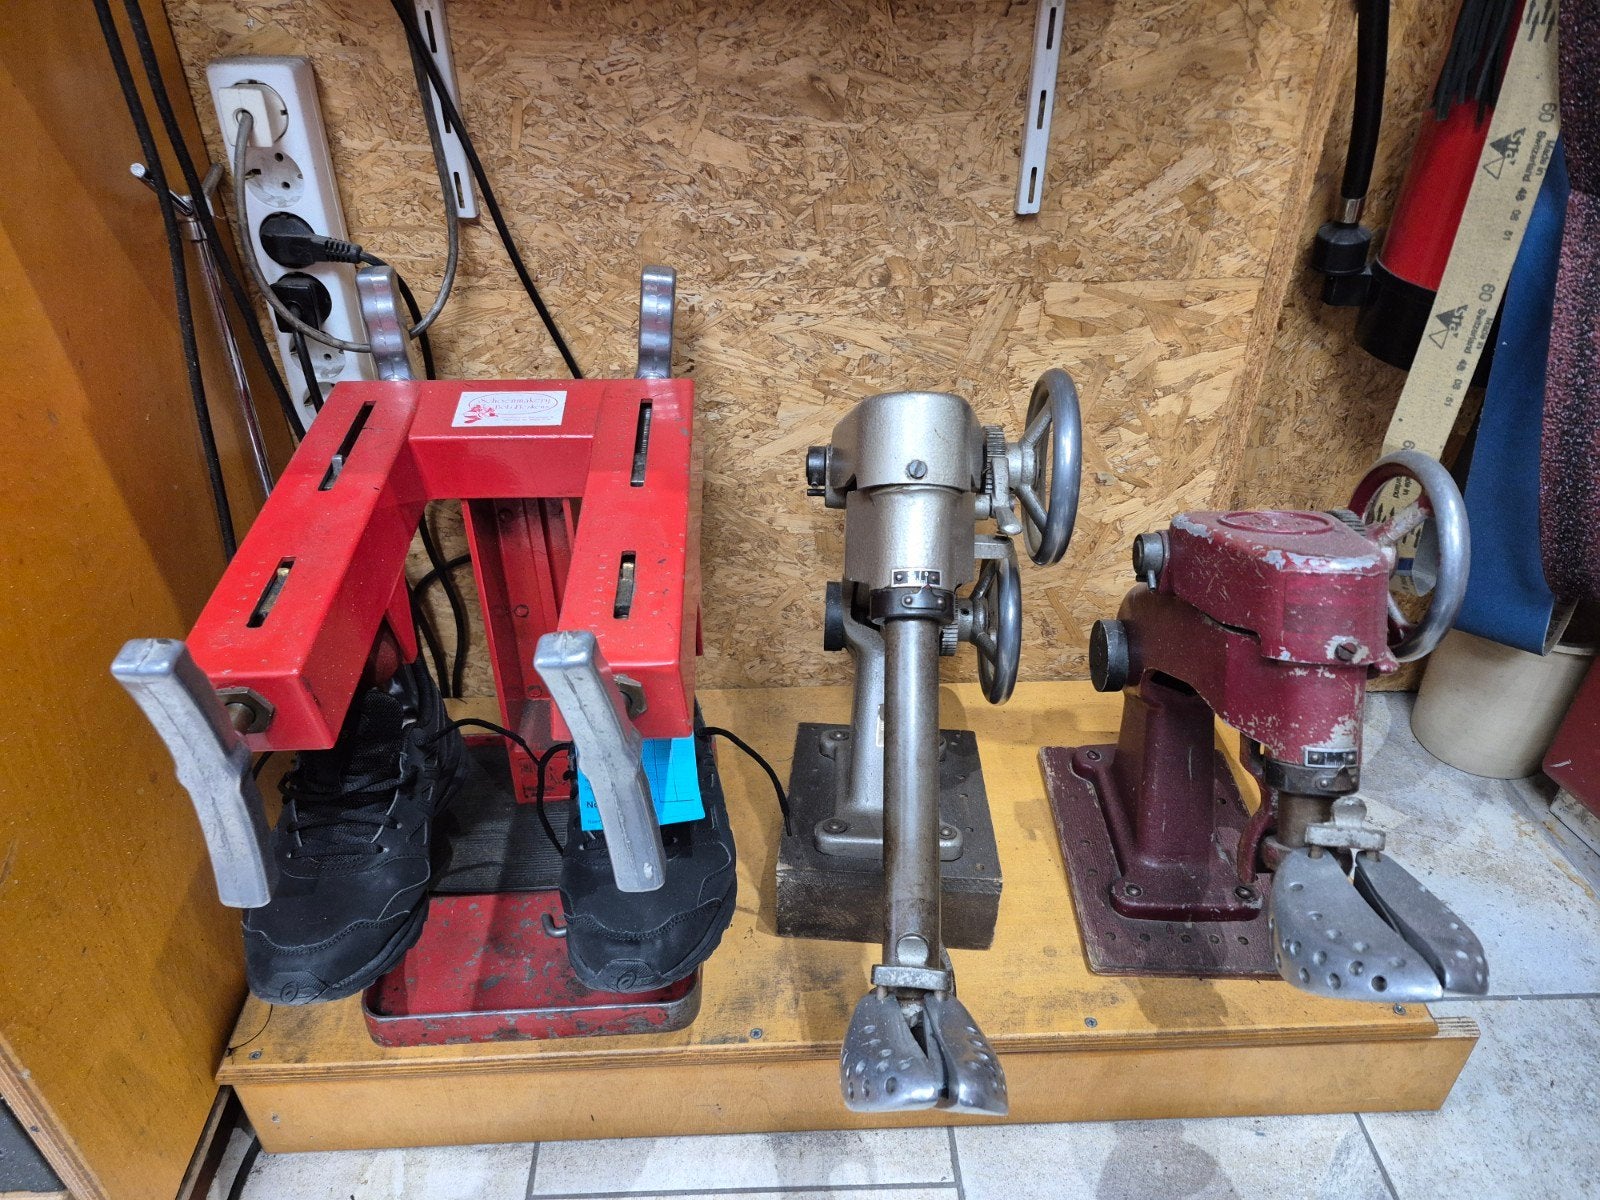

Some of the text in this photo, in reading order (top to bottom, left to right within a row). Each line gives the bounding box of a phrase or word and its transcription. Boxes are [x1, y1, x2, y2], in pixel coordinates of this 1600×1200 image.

[1539, 103, 1557, 122] 60
[1522, 131, 1547, 182] Switzerland
[1479, 283, 1496, 302] 60
[1464, 308, 1487, 354] Switzerland
